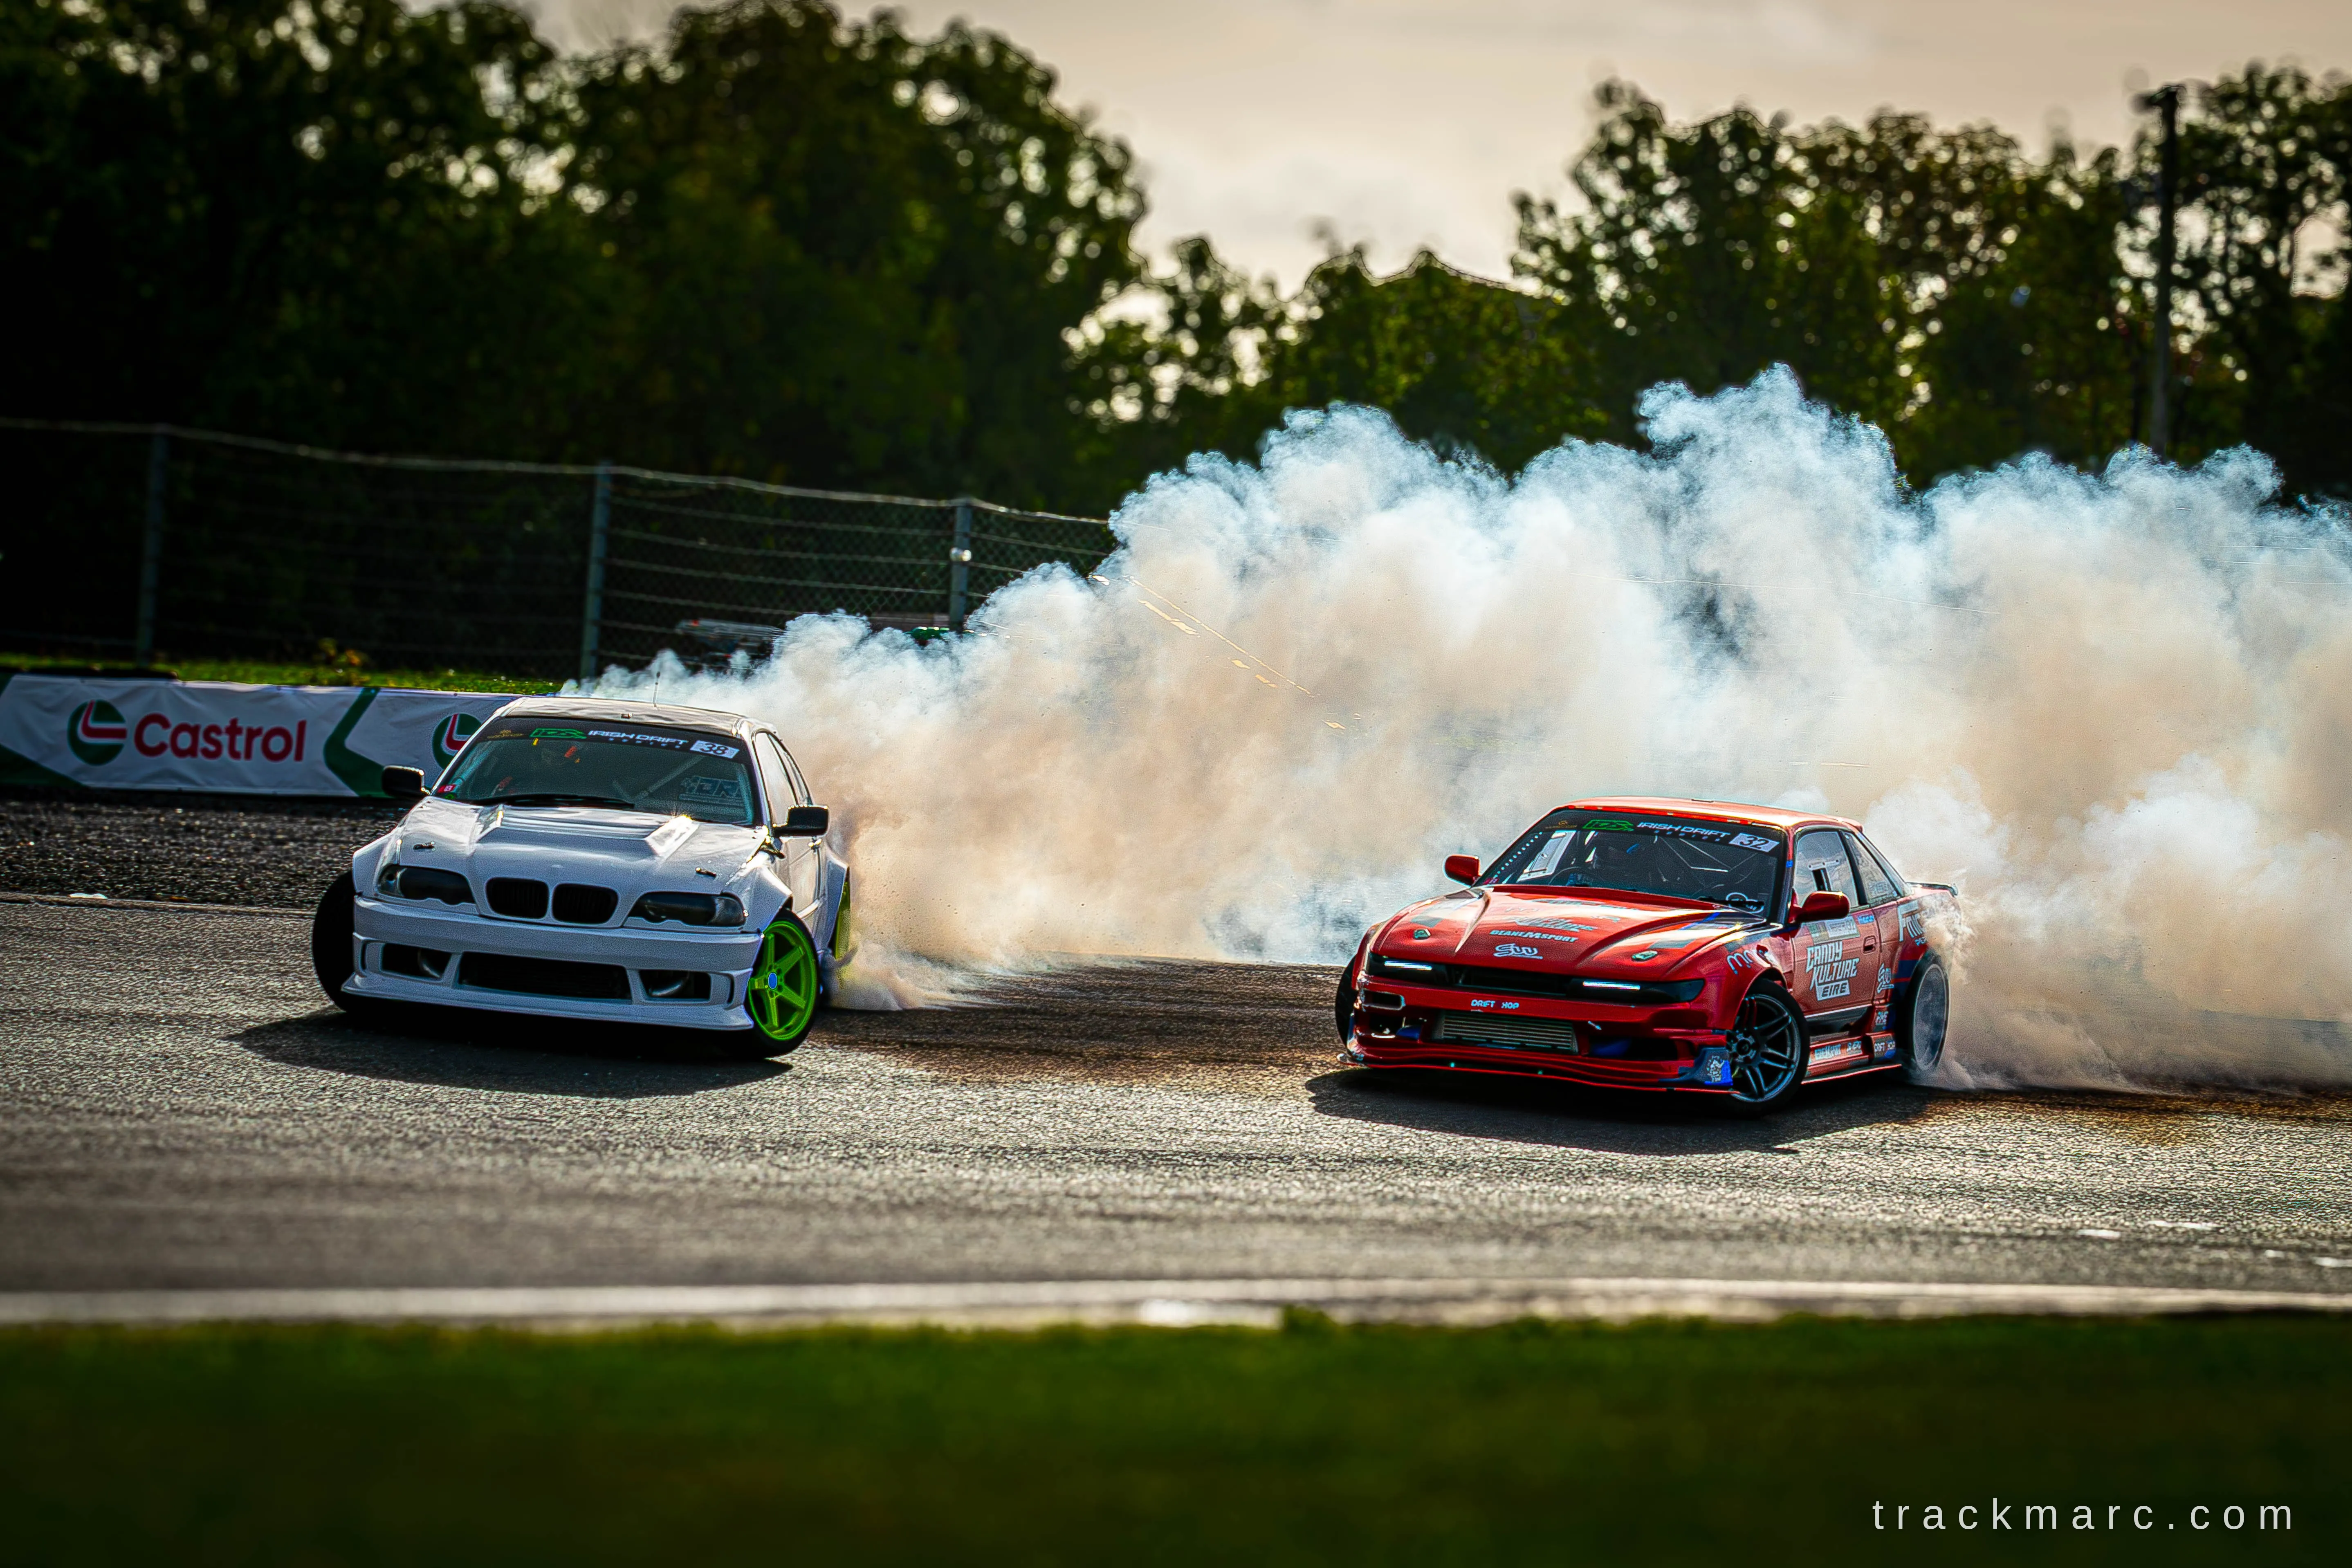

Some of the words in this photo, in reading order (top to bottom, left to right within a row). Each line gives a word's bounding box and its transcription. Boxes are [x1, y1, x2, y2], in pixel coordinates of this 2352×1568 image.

[134, 713, 307, 762] Castrol
[588, 730, 635, 739] IRISH
[635, 734, 689, 745] DRIFT
[700, 743, 729, 755] 38
[1637, 821, 1681, 831] IRISH
[1680, 826, 1730, 838] DRIFT
[1740, 835, 1769, 849] 32
[1806, 940, 1843, 974] CANDY
[1809, 957, 1860, 991] KULTURE
[1822, 982, 1847, 997] EIRE
[1471, 999, 1495, 1008] DRIFT
